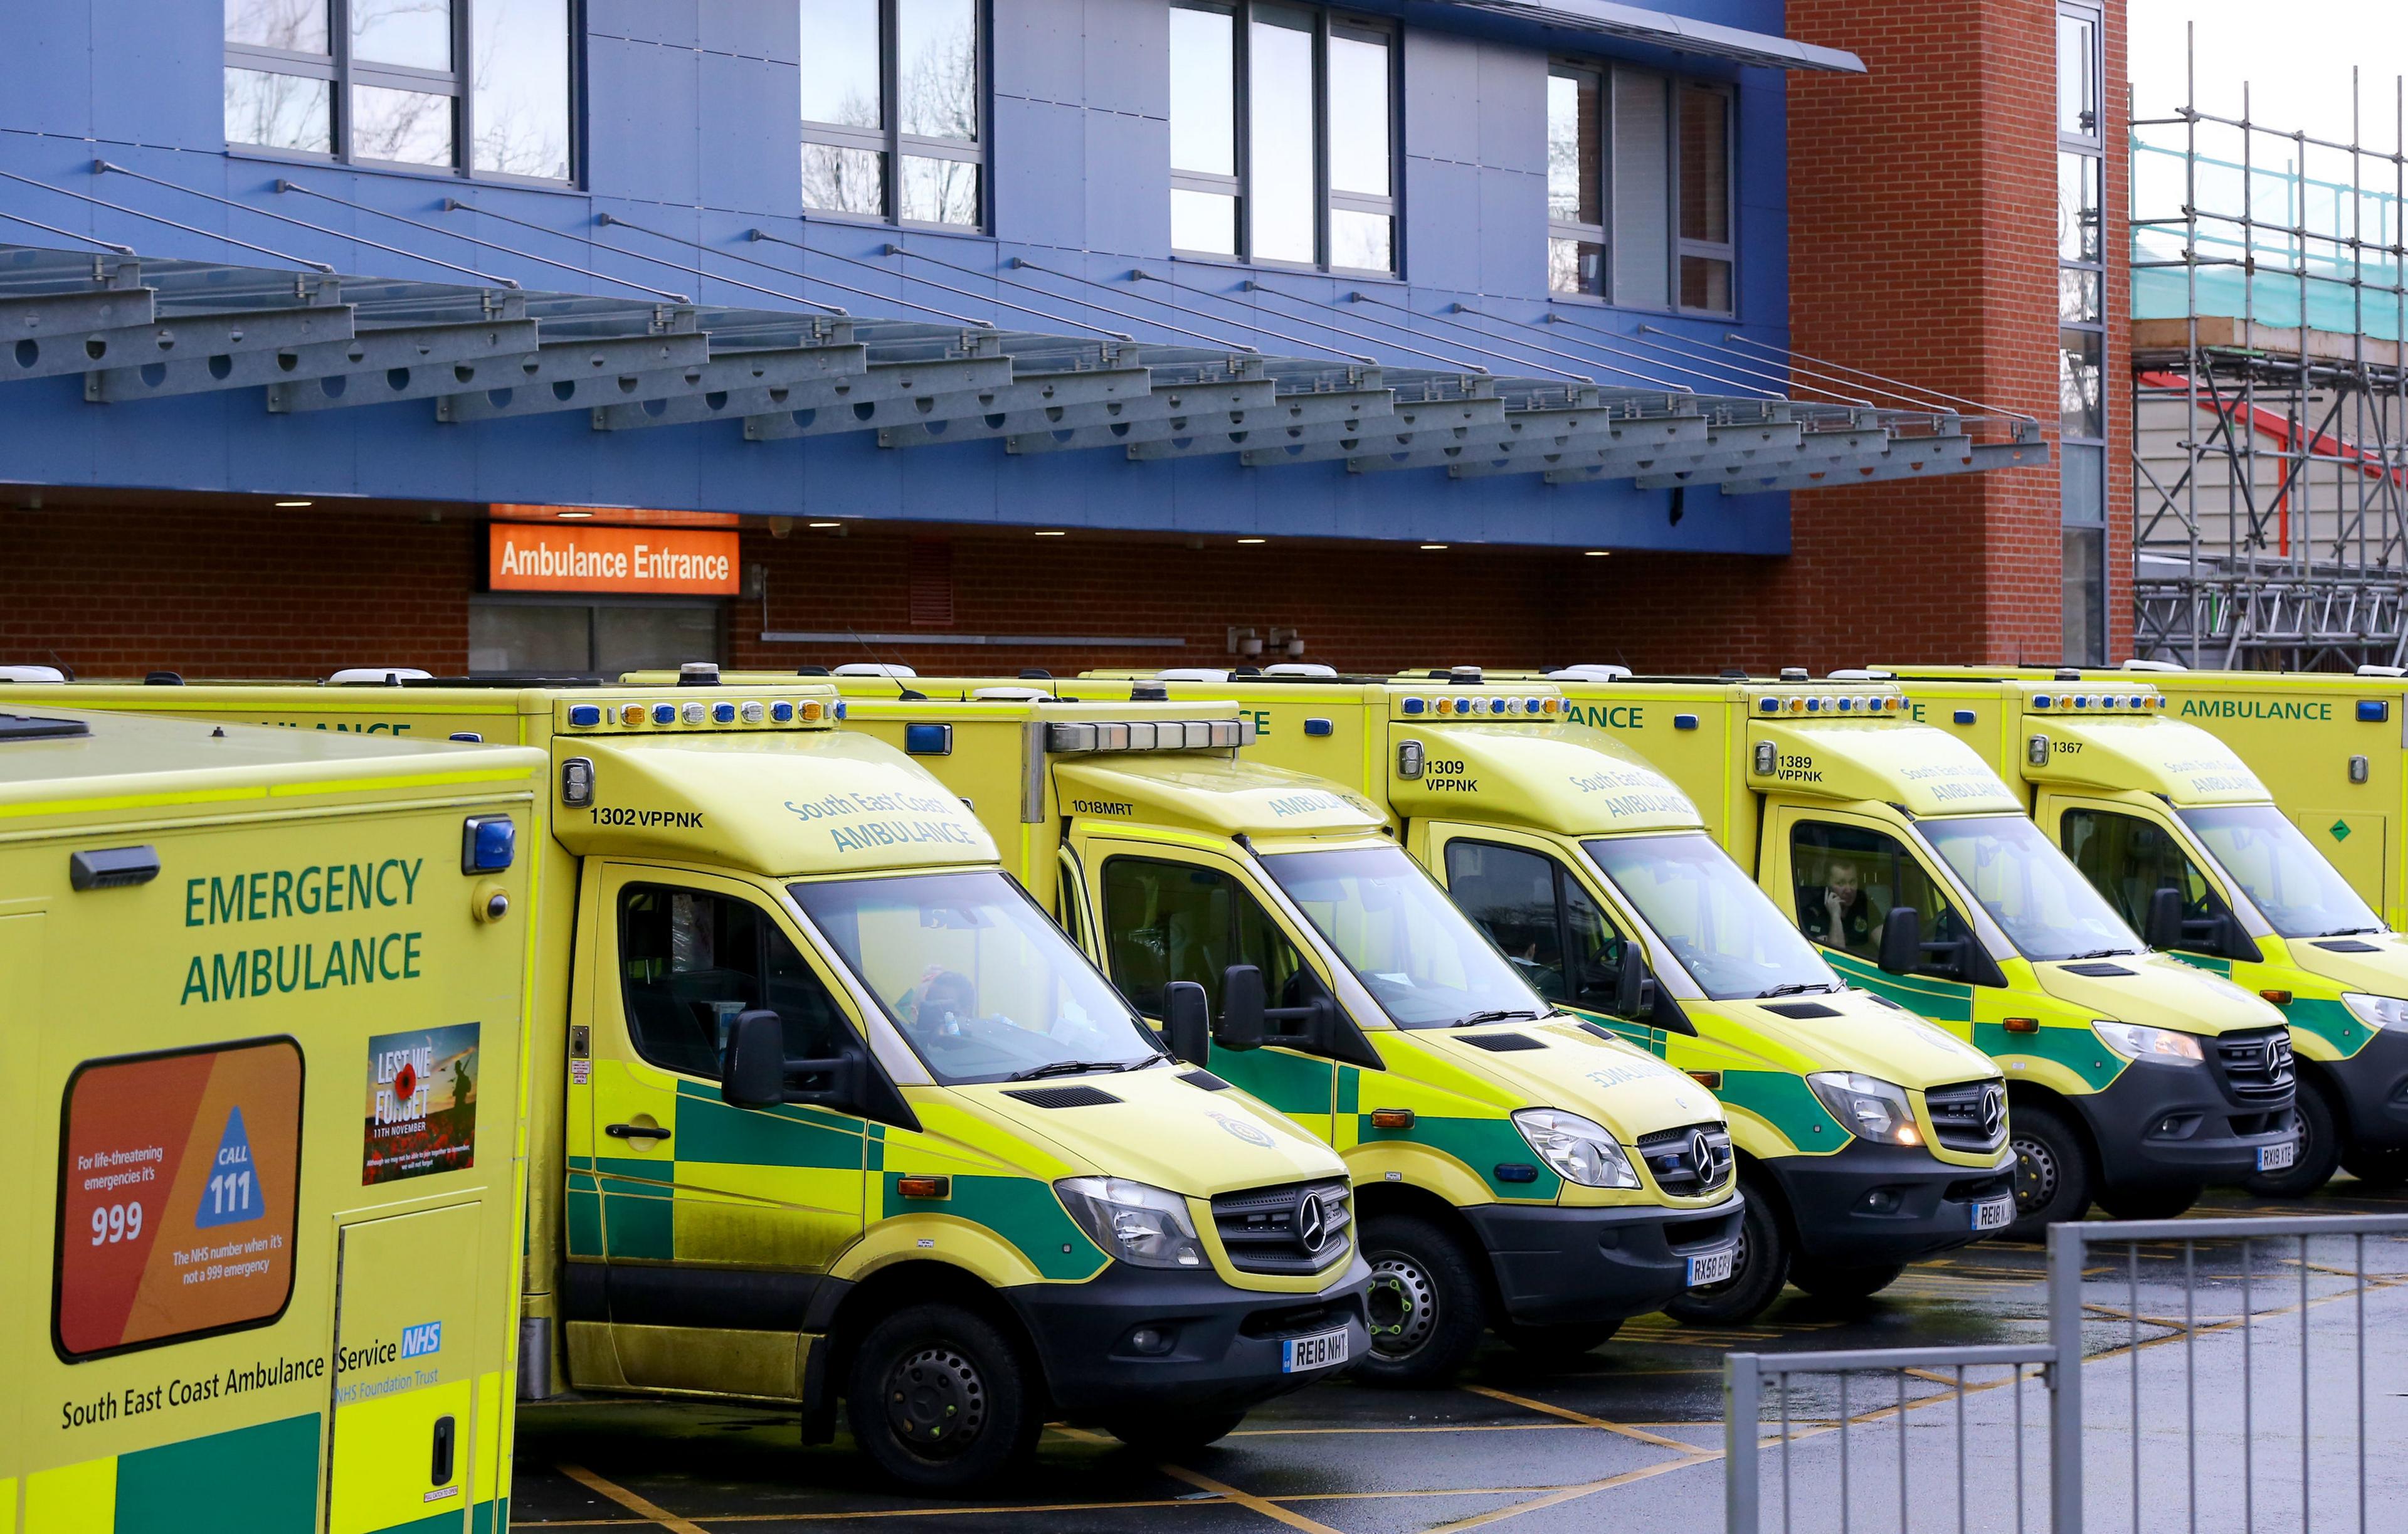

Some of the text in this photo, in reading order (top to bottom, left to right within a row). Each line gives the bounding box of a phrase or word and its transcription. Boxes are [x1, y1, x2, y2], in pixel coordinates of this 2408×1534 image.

[501, 541, 729, 580] Ambulance Entrance
[2180, 700, 2331, 720] AMBULANCE
[2052, 742, 2083, 753] 1367
[1426, 760, 1464, 775] 1309
[1779, 756, 1812, 768] 1389
[1425, 779, 1477, 791] VPPNK
[1569, 771, 1616, 793] South
[1778, 770, 1822, 782] VPPNK
[1930, 783, 2012, 801] AMBULANC
[784, 791, 954, 821] South East Coast
[1072, 800, 1133, 815] 1018MRT
[1605, 794, 1694, 818] AMBULANC
[830, 821, 976, 853] AMBULANCE
[185, 857, 423, 928] EMERGENCY
[181, 931, 422, 1005] AMBULANCE
[412, 1046, 432, 1079] WE
[375, 1084, 430, 1126] FORGET
[374, 1121, 426, 1138] 11TH NOVEMBER
[78, 1145, 163, 1170] For life-threatening
[219, 1146, 248, 1165] CALL
[2264, 1146, 2291, 1166] RX19 XTE
[84, 1169, 140, 1190] emergencies
[210, 1171, 250, 1214] 111
[92, 1201, 142, 1246] 999
[1982, 1205, 2000, 1225] RE18
[173, 1252, 188, 1266] The
[191, 1247, 209, 1263] NHS
[211, 1242, 243, 1259] number
[245, 1238, 268, 1253] when
[183, 1259, 270, 1284] not a 999 emergency
[1695, 1257, 1717, 1281] RX58
[1297, 1334, 1345, 1366] RE18 NHT
[62, 1323, 441, 1429] South East Coast Ambulance Service NHS
[335, 1368, 438, 1404] NHS Foundation Trust
